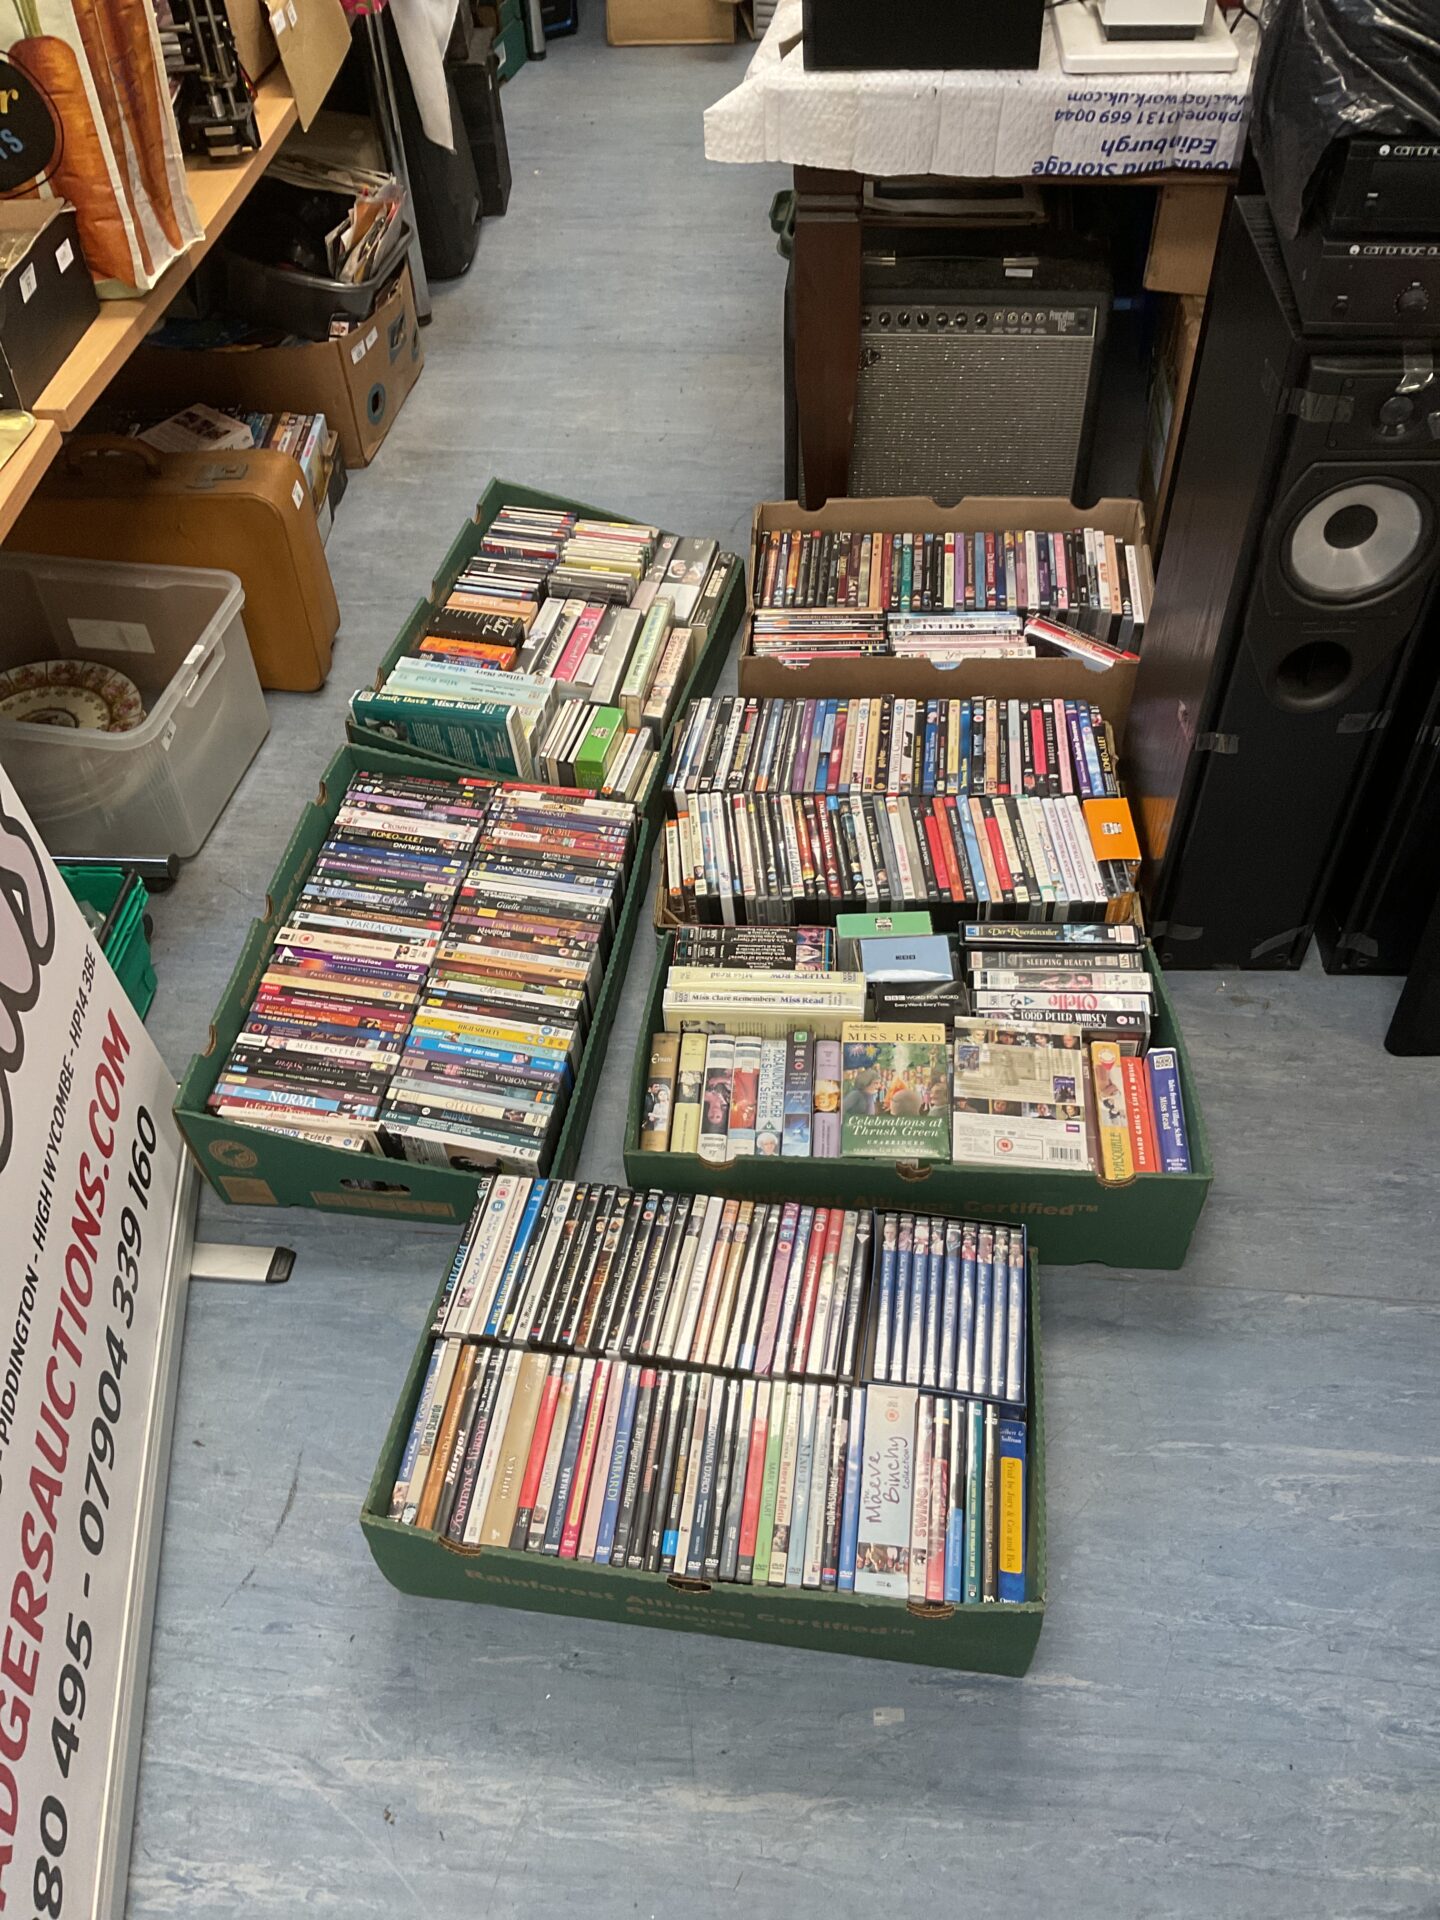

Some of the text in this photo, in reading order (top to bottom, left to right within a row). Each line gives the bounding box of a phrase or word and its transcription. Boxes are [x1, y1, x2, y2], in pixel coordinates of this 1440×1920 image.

[1054, 108, 1131, 123] 669 0044
[1101, 135, 1217, 156] Edinburgh
[1031, 156, 1118, 175] Storage
[375, 692, 480, 710] Emily Davis Miss Read
[381, 821, 418, 833] CROMWELL
[392, 841, 436, 853] MAYERLING
[494, 864, 565, 879] JOAN SUTHERLAND
[496, 900, 520, 911] Giselle
[344, 918, 403, 934] SPARTACUS
[988, 928, 1008, 936] Der
[485, 966, 522, 979] CARMEN
[780, 996, 800, 1004] Miss
[801, 996, 824, 1005] Read
[1048, 994, 1097, 1010] Otello
[1021, 1011, 1107, 1023] LORD PETER WIMSEY
[896, 1034, 941, 1042] READ
[295, 1042, 361, 1057] MISS POTTER
[494, 1073, 527, 1085] NORMA
[267, 1090, 316, 1108] NORMA
[848, 1116, 942, 1127] Celebrations at
[1160, 1097, 1170, 1129] Miss Read
[1172, 1110, 1180, 1127] Village
[852, 1126, 938, 1136] Thrush Green
[1174, 1128, 1183, 1146] School
[1137, 1137, 1146, 1164] EDVARD
[0, 944, 97, 1446] PIDDINGTON HIGH WYCOMBE HP14 3BE
[466, 1233, 493, 1286] Doc Martin
[631, 1238, 645, 1267] RACHEL
[444, 1242, 469, 1292] PAVLOVA
[490, 1308, 501, 1325] KING
[508, 1249, 520, 1272] MINES
[477, 1377, 491, 1411] The Perfect
[417, 1402, 442, 1457] Maria Stuarda
[634, 1426, 644, 1440] Der
[51, 1105, 156, 1779] 495 07904 339 160
[443, 1428, 468, 1485] Margot
[627, 1440, 642, 1472] fliegende
[699, 1423, 718, 1494] GIOVANNA D'ARCO
[448, 1475, 473, 1535] FONTEYN
[464, 1414, 488, 1468] NUREYEV
[499, 1454, 516, 1499] OPERA
[603, 1438, 627, 1502] LOMBARDI
[882, 1436, 908, 1505] Binchy
[1006, 1461, 1015, 1479] Trial
[557, 1466, 571, 1499] SAHARA
[762, 1461, 777, 1517] MARY STUART
[866, 1451, 882, 1524] Maeve
[1004, 1491, 1015, 1508] Jury
[914, 1487, 928, 1537] SWING
[1006, 1519, 1014, 1534] Cox
[1006, 1536, 1014, 1550] and
[1006, 1553, 1015, 1568] Box
